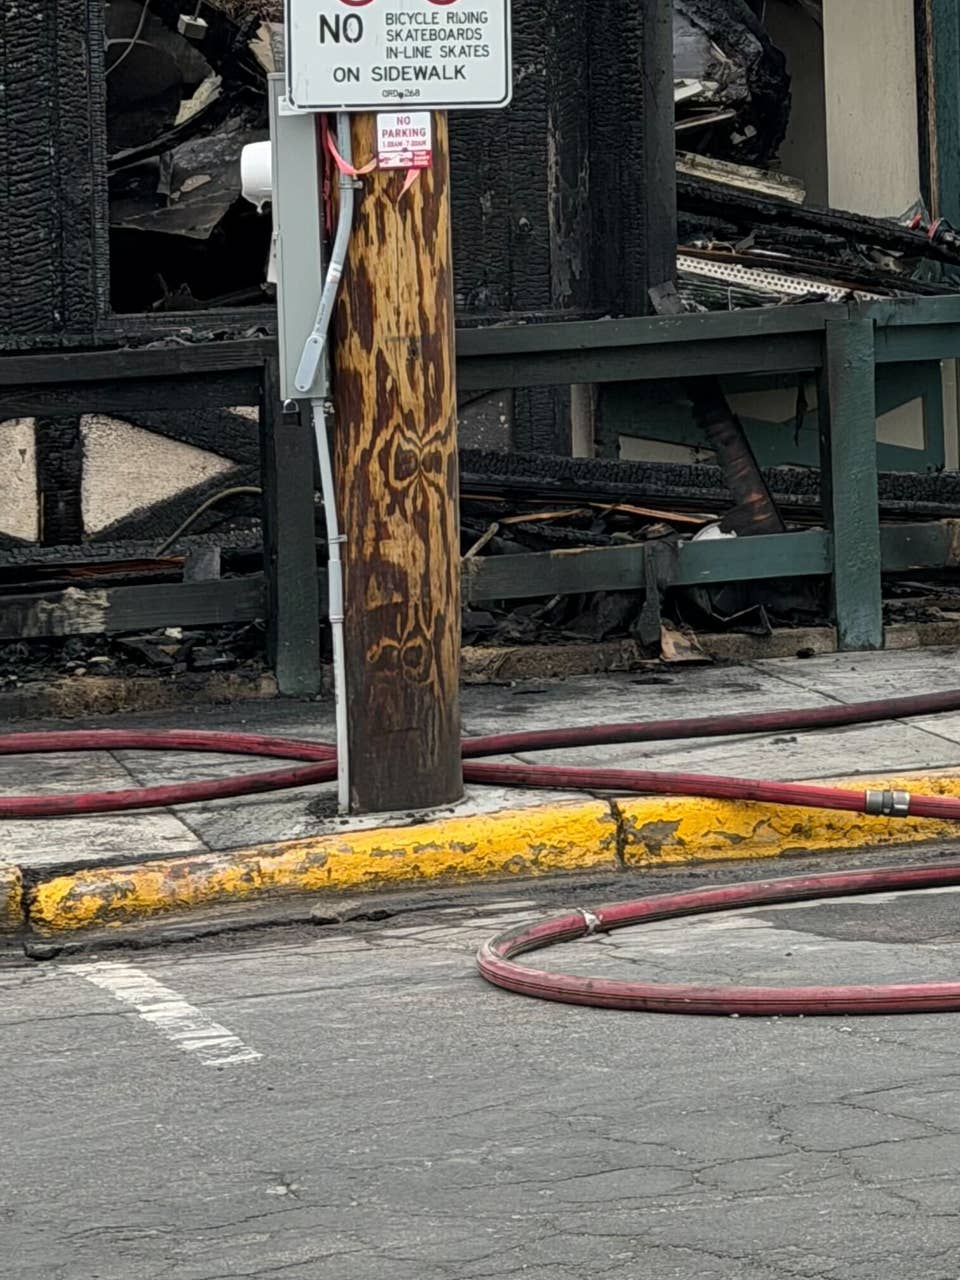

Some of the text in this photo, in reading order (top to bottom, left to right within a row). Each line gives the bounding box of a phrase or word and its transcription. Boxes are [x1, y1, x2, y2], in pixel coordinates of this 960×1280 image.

[385, 11, 489, 26] BICYCLE RIDING
[319, 13, 363, 44] NO
[386, 28, 483, 42] SKATEBOARDS
[386, 44, 490, 59] IN-LINE SKATES
[333, 64, 467, 83] ON SIDEWALK
[396, 116, 411, 126] NO
[382, 127, 427, 138] PARKING
